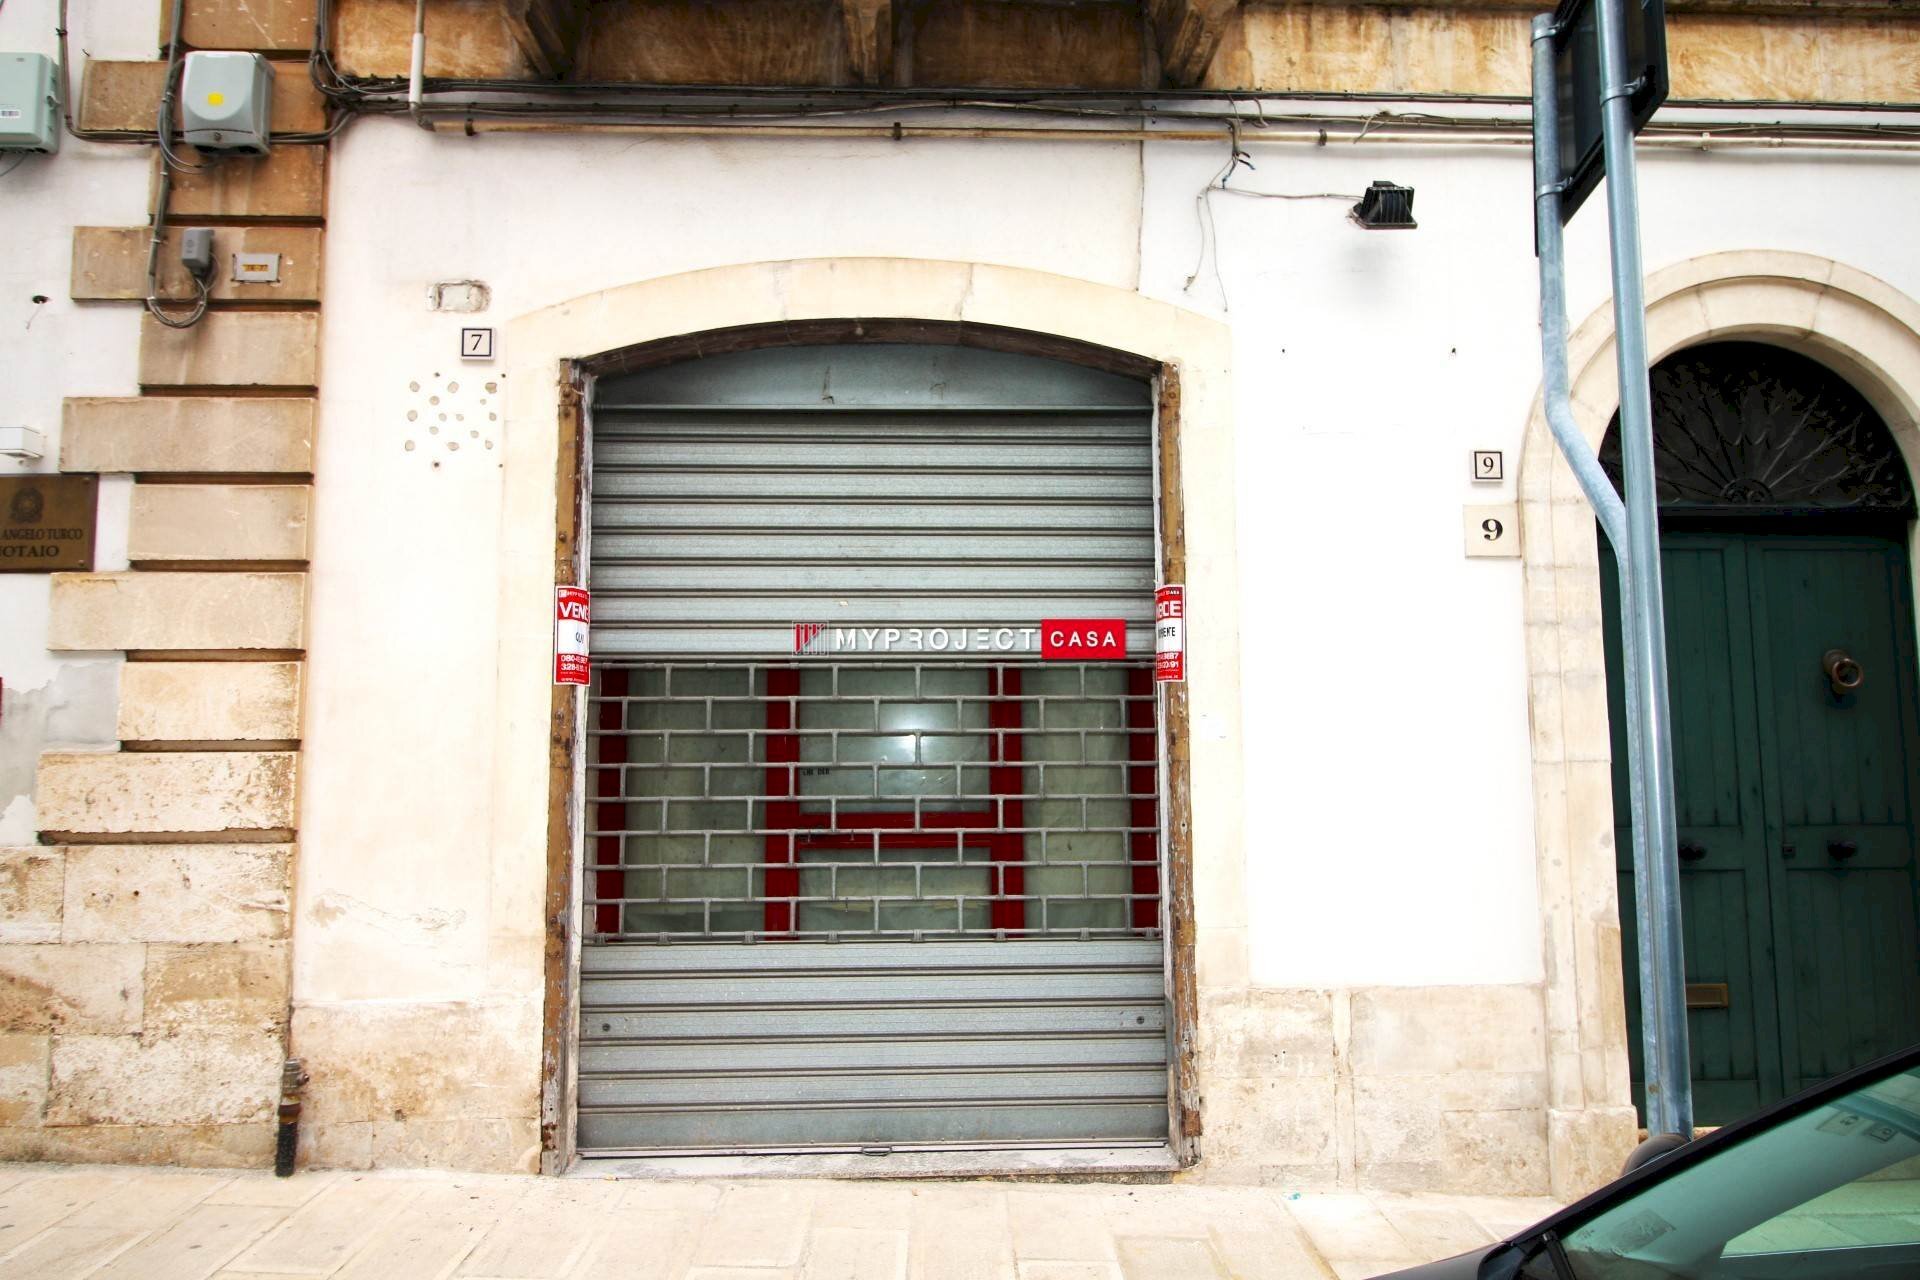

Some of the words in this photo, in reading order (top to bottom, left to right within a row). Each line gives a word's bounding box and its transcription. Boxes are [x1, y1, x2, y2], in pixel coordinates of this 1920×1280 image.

[470, 333, 483, 351] 7
[1483, 456, 1494, 474] 9
[2, 528, 45, 540] ANGELO
[1481, 518, 1504, 541] 9
[835, 627, 1037, 651] MYPROJECT
[1049, 630, 1117, 648] CASA
